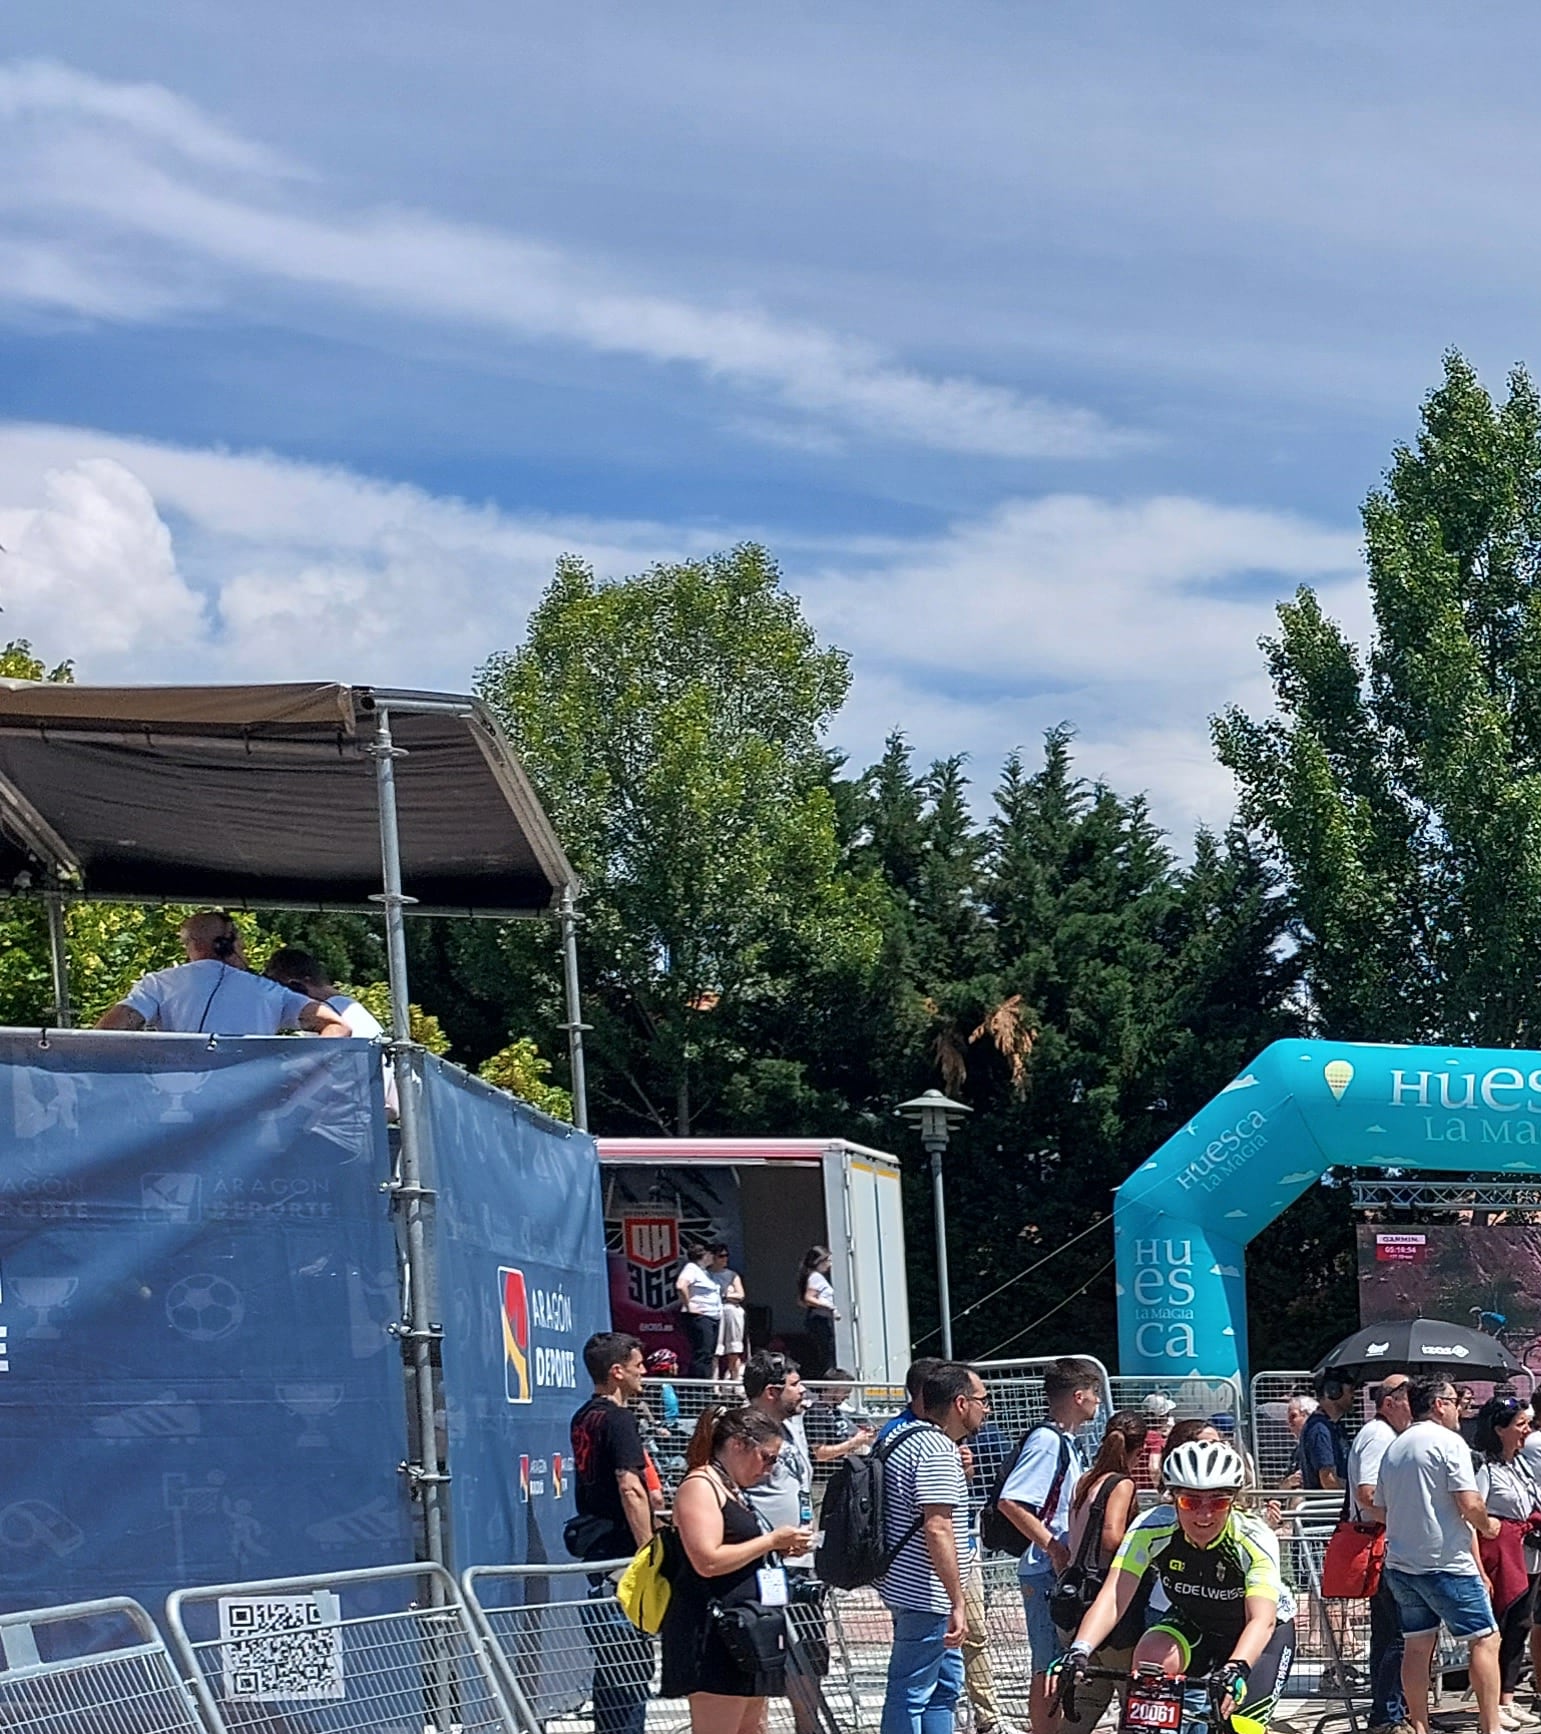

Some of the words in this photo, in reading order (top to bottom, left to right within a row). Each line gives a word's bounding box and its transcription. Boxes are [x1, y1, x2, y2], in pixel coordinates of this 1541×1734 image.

[532, 1284, 573, 1333] ARAGÓN
[536, 1347, 576, 1389] DEPORTE
[1174, 1582, 1246, 1601] EDELWEISS
[1129, 1703, 1176, 1724] 20061
